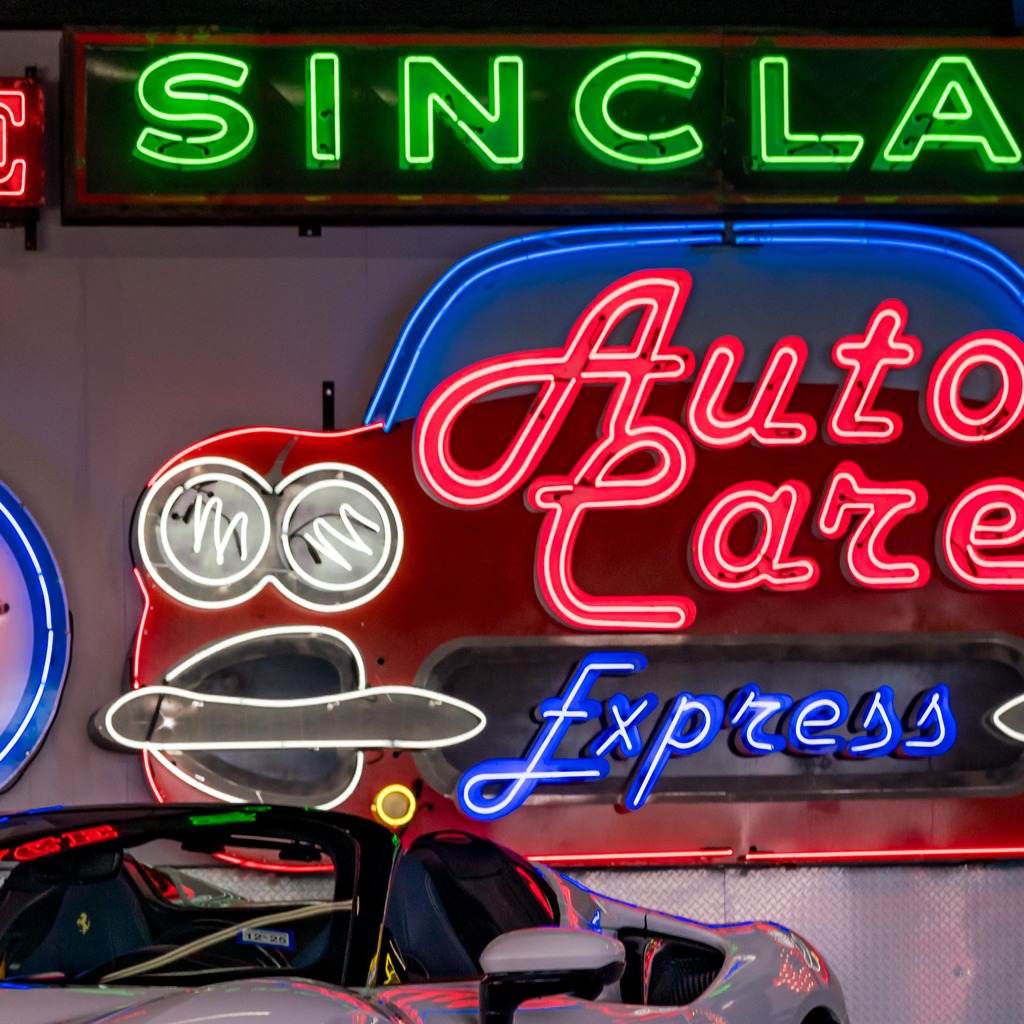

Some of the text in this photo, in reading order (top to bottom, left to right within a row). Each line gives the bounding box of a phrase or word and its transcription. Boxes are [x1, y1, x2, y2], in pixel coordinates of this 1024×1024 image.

[133, 50, 1023, 171] SINCLA
[413, 268, 1024, 508] Auto
[525, 414, 1024, 631] Care
[456, 651, 958, 821] Express
